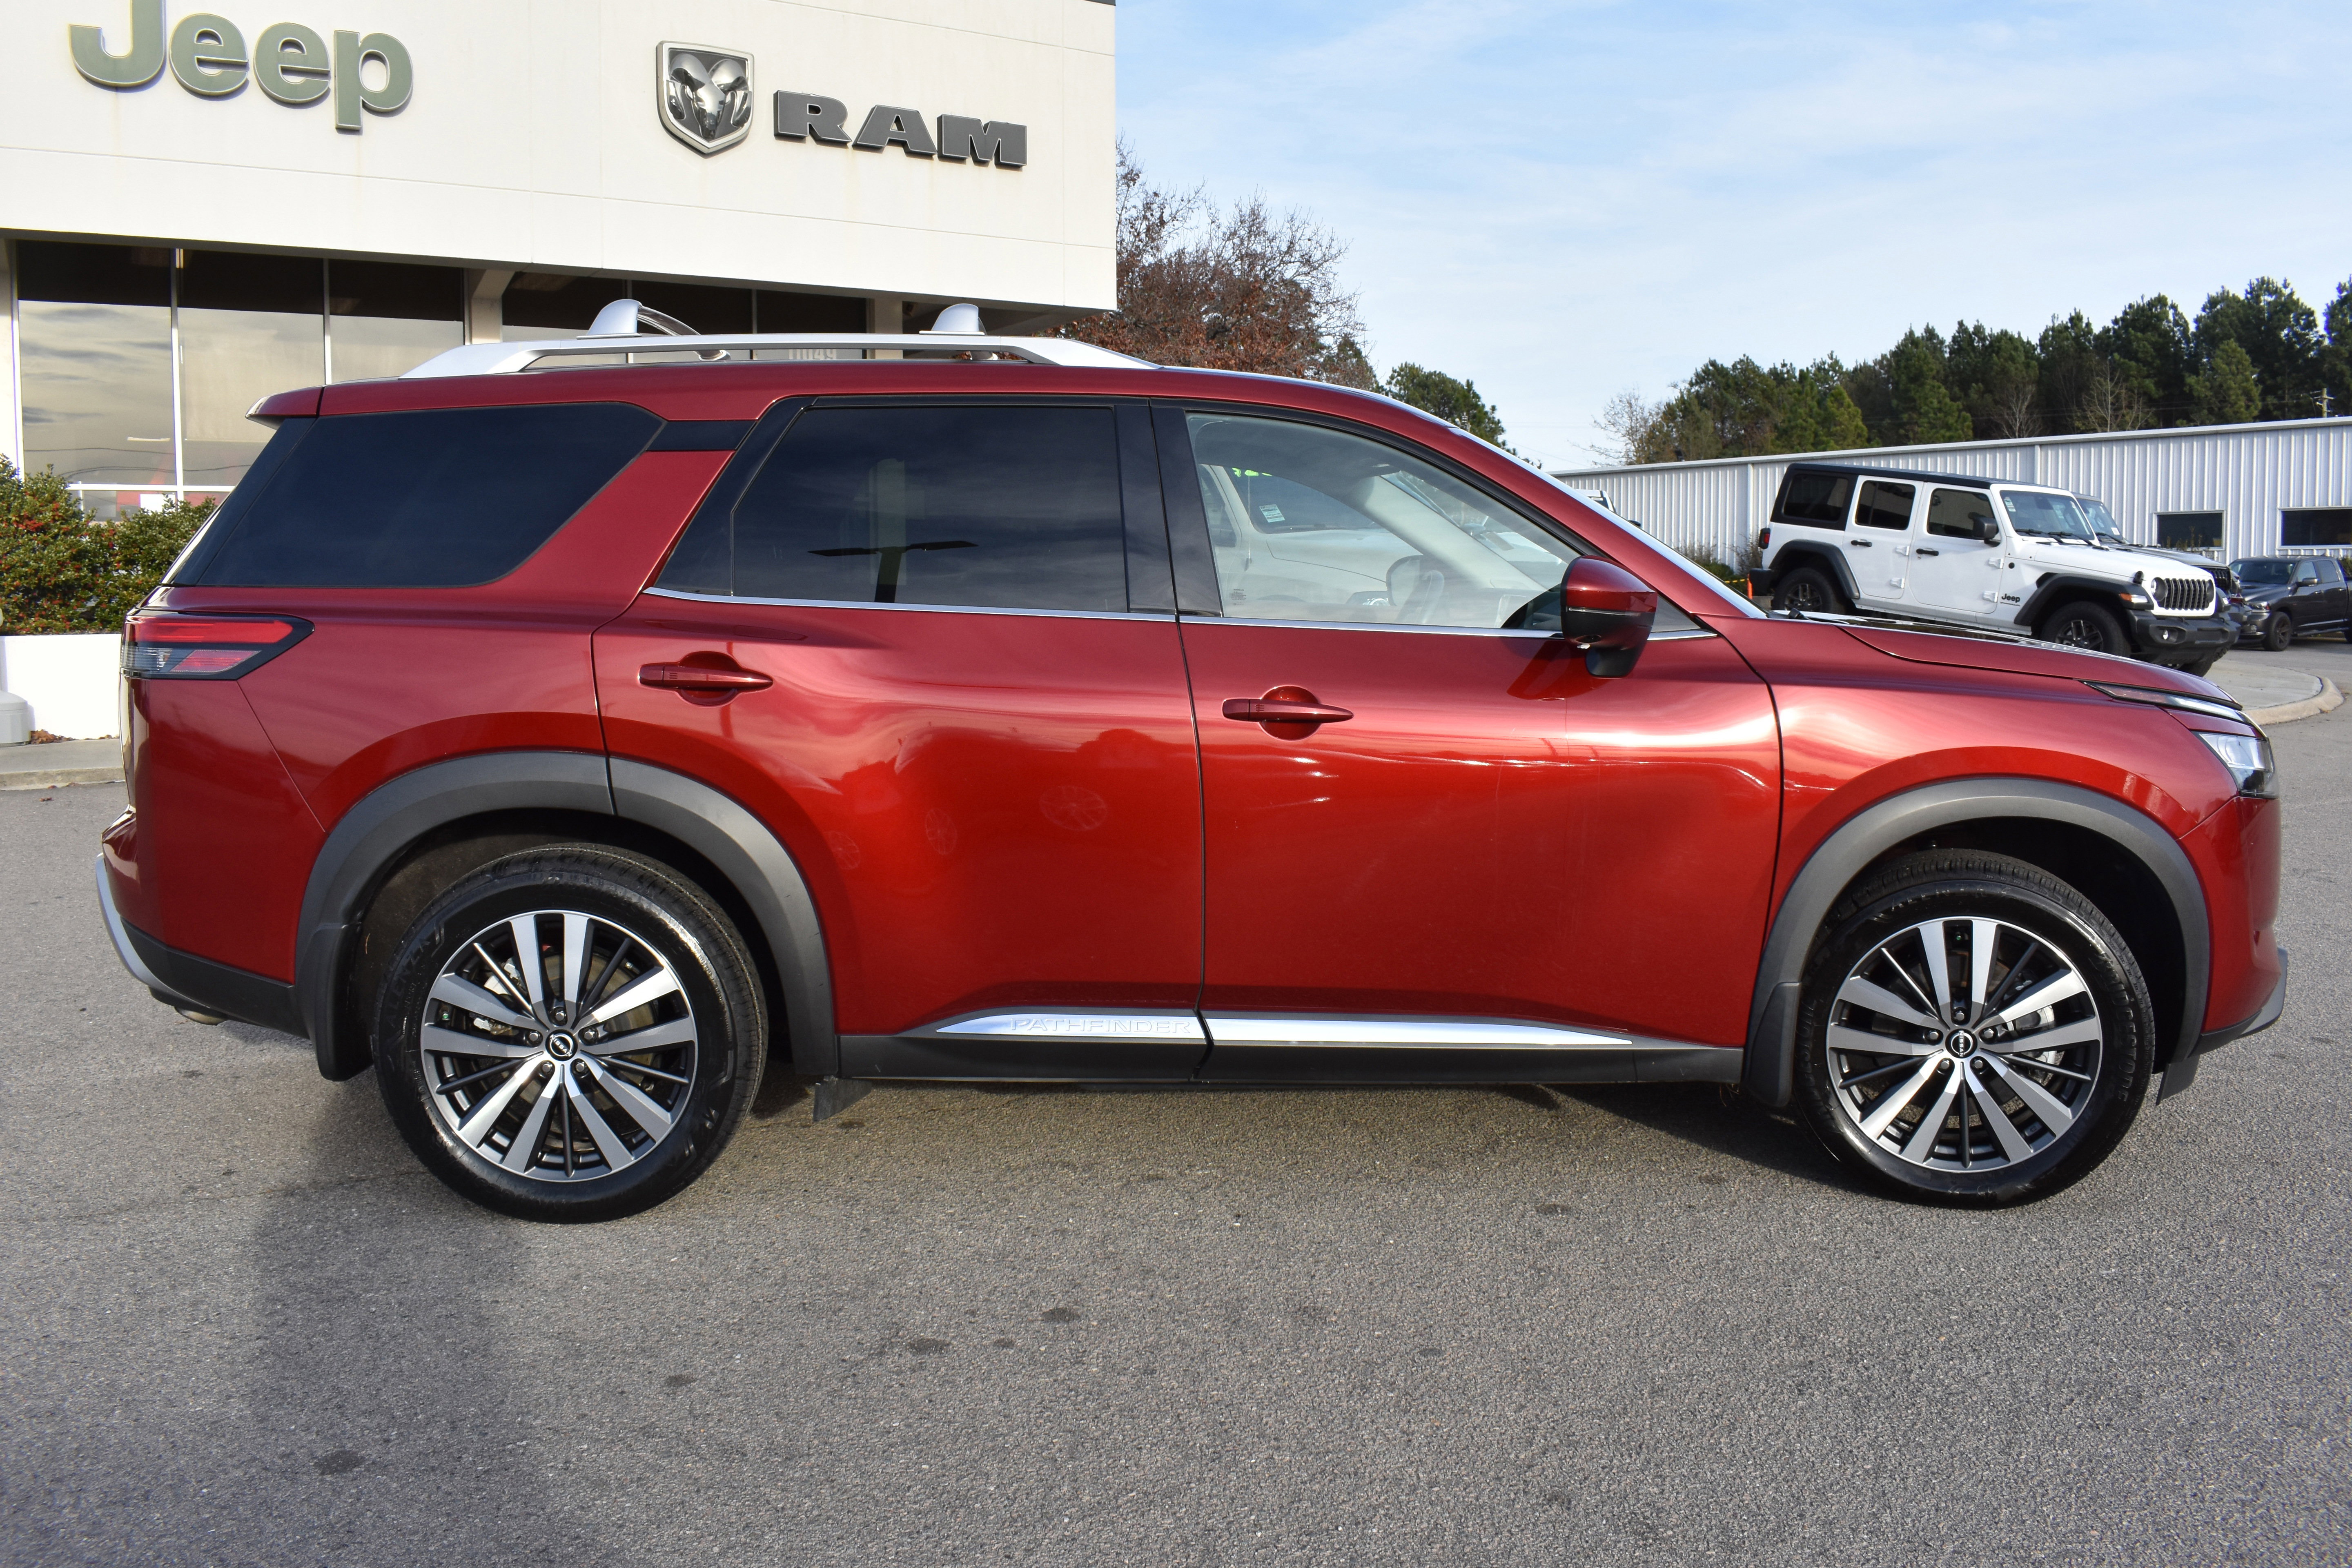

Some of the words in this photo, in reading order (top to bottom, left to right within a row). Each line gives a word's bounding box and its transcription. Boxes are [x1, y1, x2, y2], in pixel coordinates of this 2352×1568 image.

[67, 0, 414, 130] Jeep
[773, 90, 1027, 167] RAM
[2001, 593, 2020, 603] Jeep
[1010, 1018, 1190, 1033] PATHFINDER
[550, 1034, 572, 1057] NISSAN
